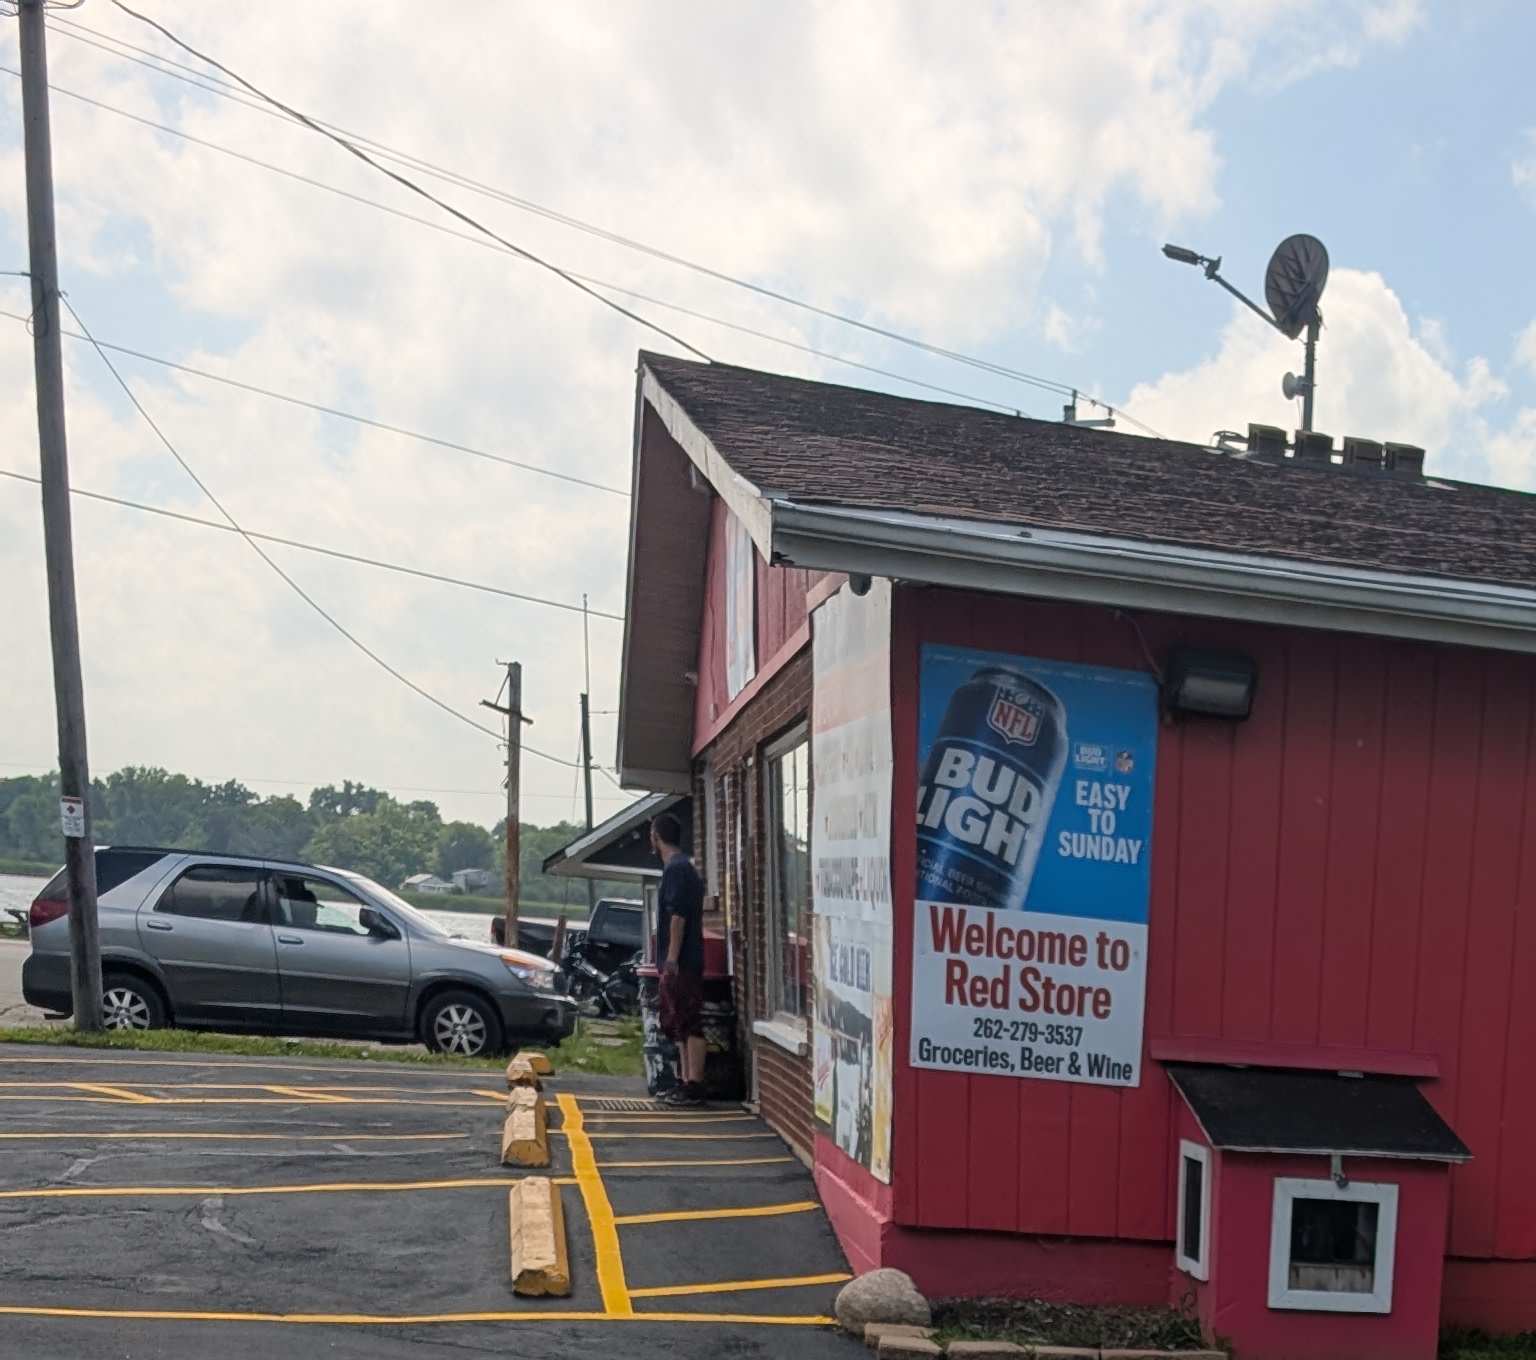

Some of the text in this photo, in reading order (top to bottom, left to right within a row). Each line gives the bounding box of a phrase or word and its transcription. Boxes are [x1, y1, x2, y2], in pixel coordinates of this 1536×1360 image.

[992, 702, 1035, 740] NFL
[933, 747, 1041, 825] BUD
[1075, 780, 1131, 811] EASY
[916, 785, 1028, 866] IGH
[1088, 808, 1117, 835] TO
[1057, 831, 1142, 865] SUNDAY
[929, 905, 1130, 971] Welcome to
[944, 958, 1112, 1020] Red Store
[973, 1017, 1083, 1047] 262-279-3537
[918, 1037, 1133, 1081] Groceries, Beer & Wine
